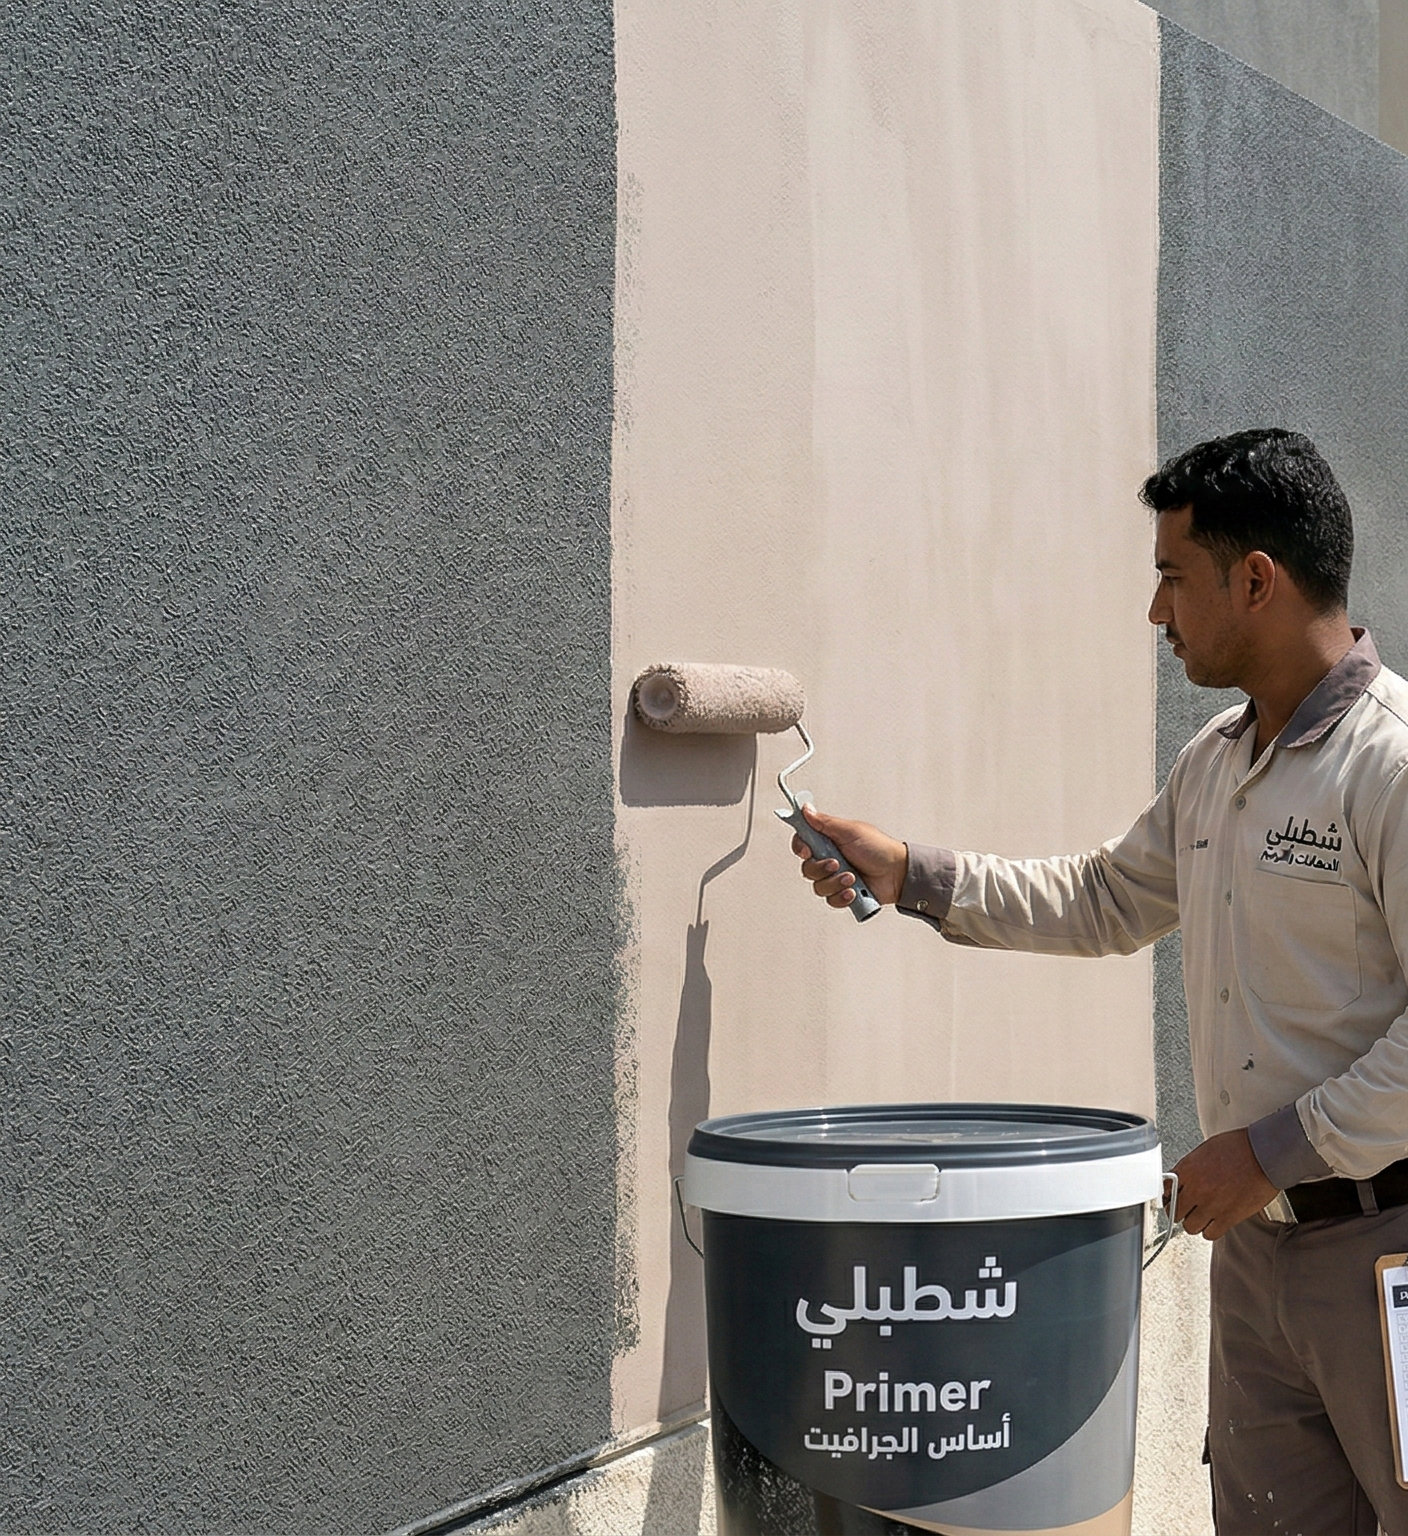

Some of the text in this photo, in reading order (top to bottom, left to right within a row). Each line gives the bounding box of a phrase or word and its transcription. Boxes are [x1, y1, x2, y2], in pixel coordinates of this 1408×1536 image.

[796, 1257, 1017, 1348] شطبلي
[825, 1371, 991, 1412] Primer
[805, 1412, 1010, 1459] أساس الجرافيت
